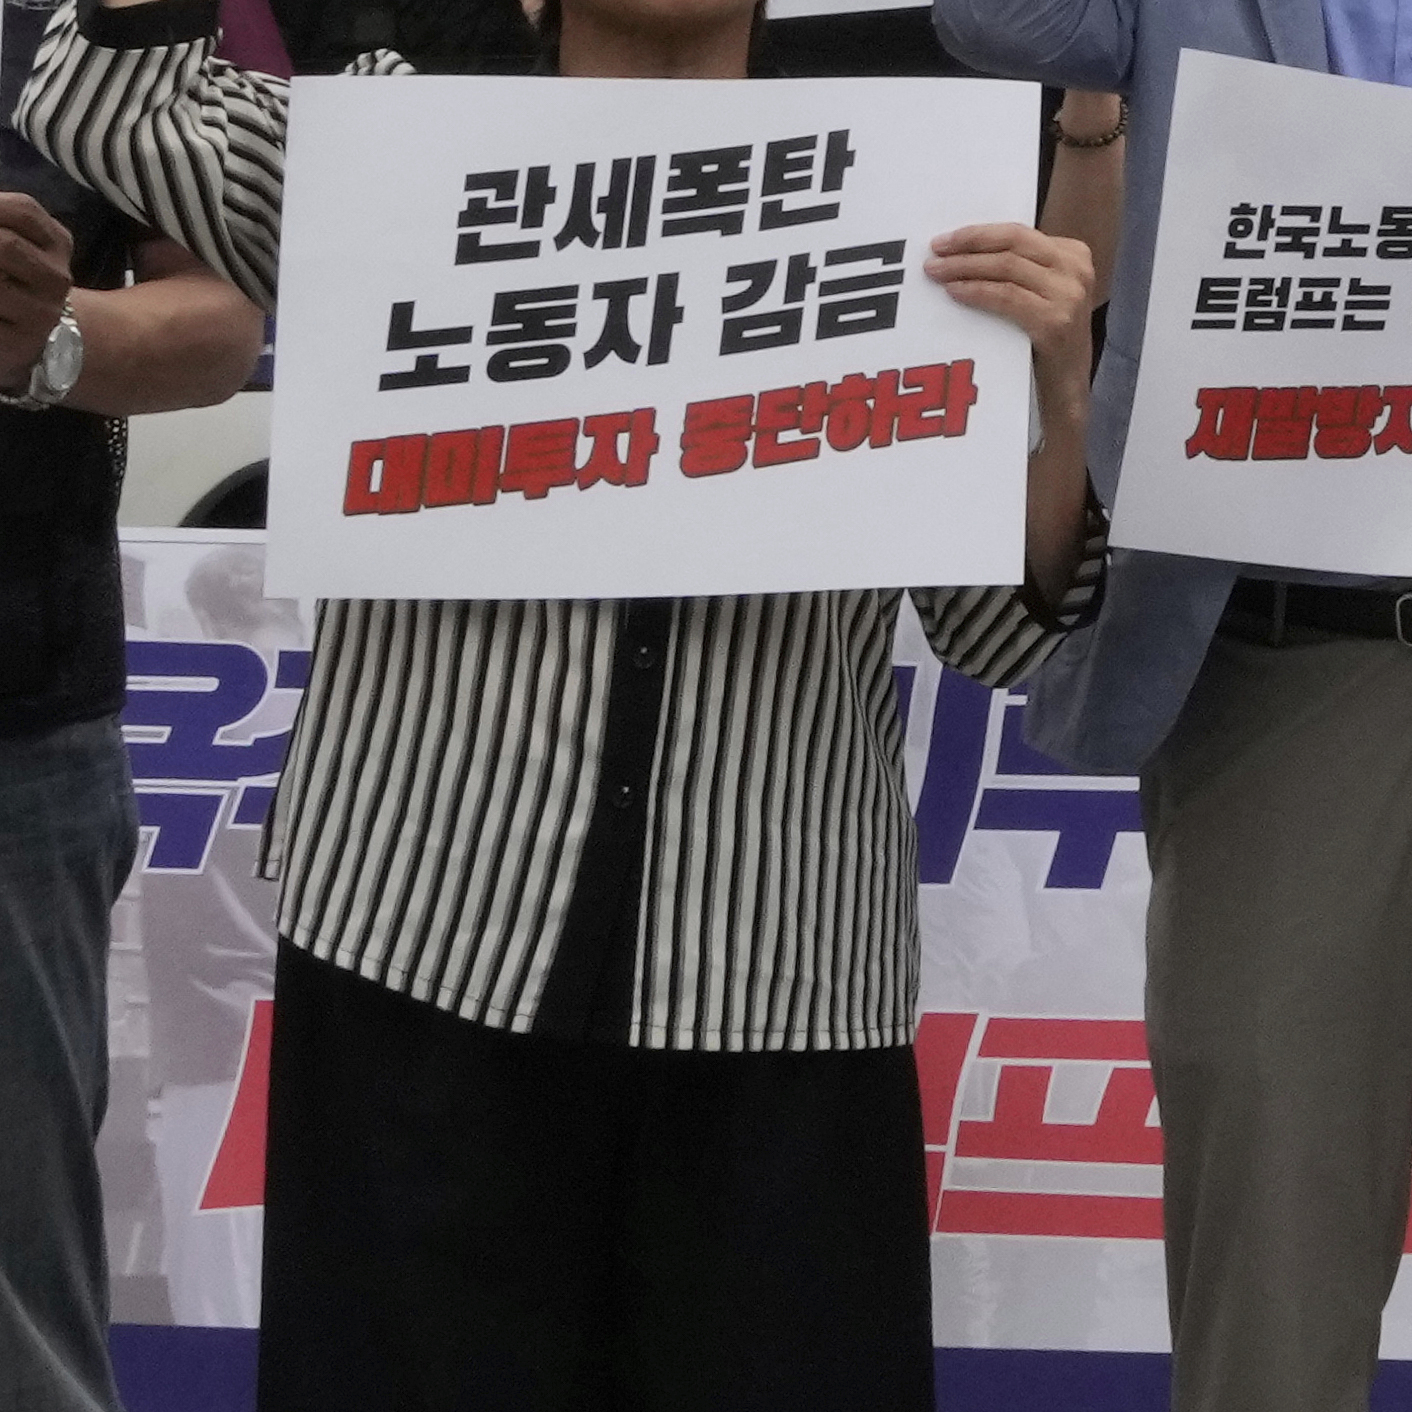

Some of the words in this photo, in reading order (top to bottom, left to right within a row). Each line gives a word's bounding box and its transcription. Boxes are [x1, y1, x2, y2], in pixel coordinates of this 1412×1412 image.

[455, 130, 855, 265] 관세폭탄
[379, 273, 684, 391] 노동자
[720, 240, 906, 355] 감금
[1191, 277, 1391, 331] 트럼프는
[345, 408, 659, 513] 대미투자
[682, 360, 977, 476] 중단하라
